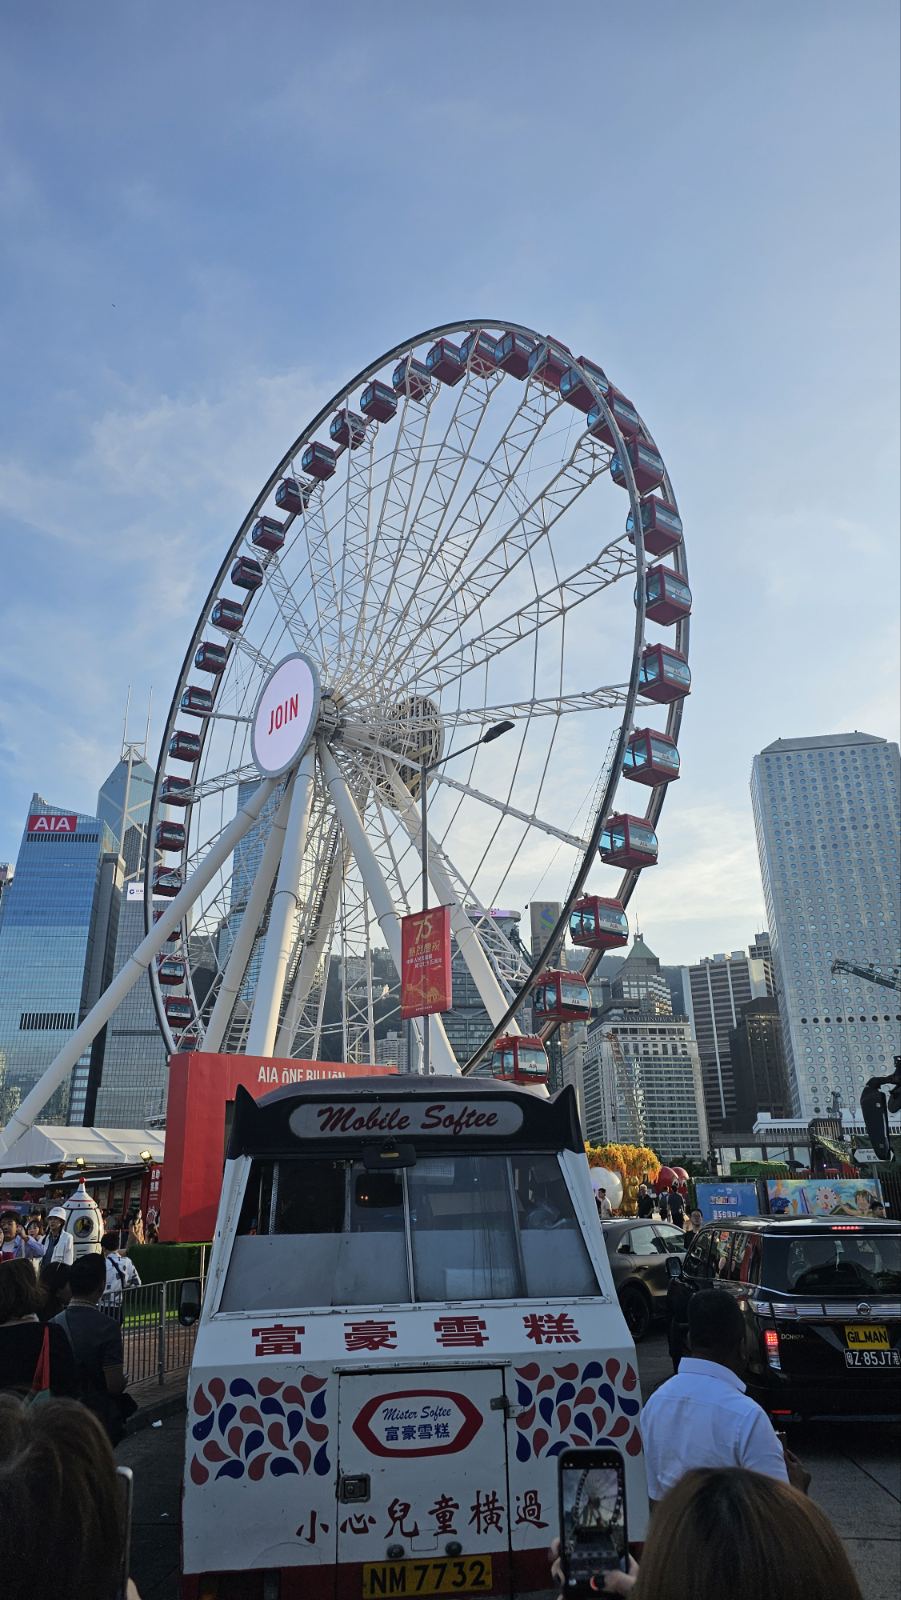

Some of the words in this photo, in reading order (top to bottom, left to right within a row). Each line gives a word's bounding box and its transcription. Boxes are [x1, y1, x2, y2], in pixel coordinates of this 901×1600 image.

[268, 693, 299, 735] JOIN
[33, 816, 71, 831] AIA
[412, 912, 433, 944] 75
[257, 1066, 279, 1083] AIA
[317, 1105, 411, 1132] Mobile
[419, 1104, 499, 1136] Softee
[251, 1312, 583, 1357] 富豪雪糕
[847, 1330, 889, 1344] GILMAN
[382, 1407, 418, 1421] Mister
[420, 1404, 452, 1421] Softee
[384, 1422, 451, 1441] 富豪雪糕
[295, 1489, 550, 1544] 小心兒童橫過
[369, 1565, 406, 1594] NM
[413, 1559, 486, 1592] 7732
